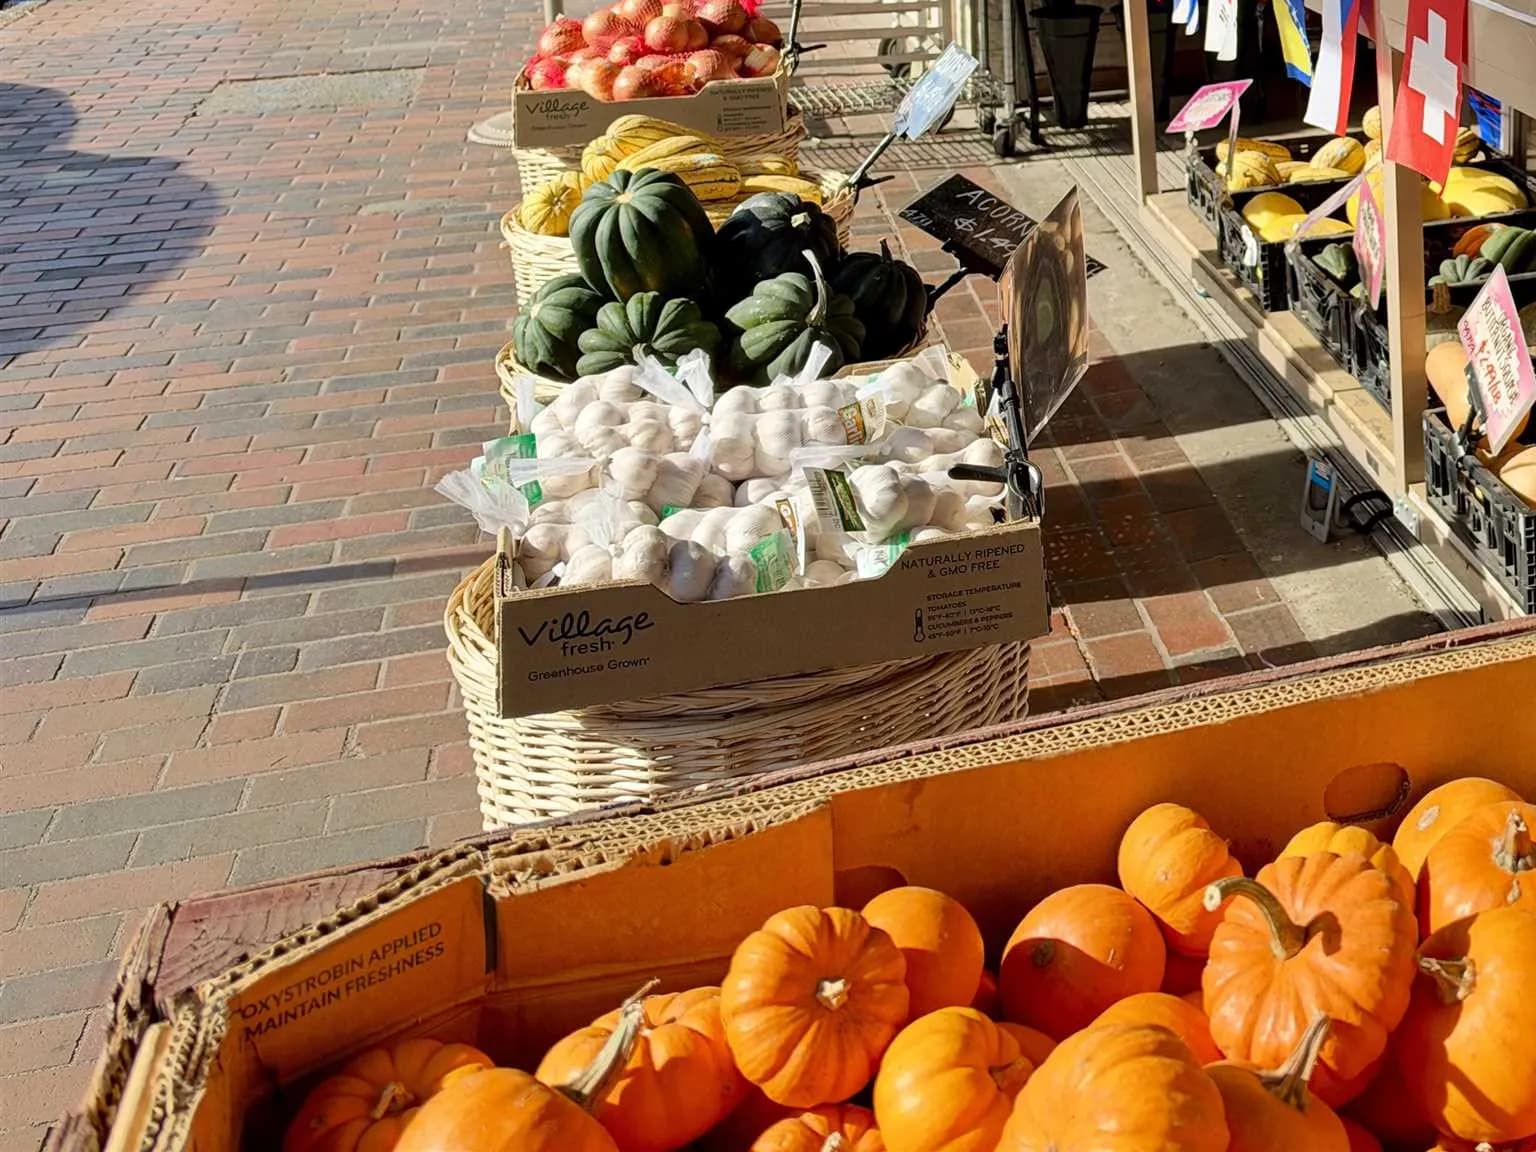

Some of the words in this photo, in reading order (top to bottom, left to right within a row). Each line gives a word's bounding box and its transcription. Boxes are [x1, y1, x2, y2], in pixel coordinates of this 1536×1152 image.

[956, 189, 1038, 238] ACORN
[901, 551, 972, 570] NATURALLY
[975, 543, 1025, 559] RIPENED
[927, 569, 937, 579] &
[940, 564, 968, 577] GMO
[971, 559, 1000, 573] FREE
[926, 590, 964, 601] STORAGE
[965, 581, 1021, 596] TEMPERATURE
[927, 601, 967, 612] TOMATOES
[518, 610, 655, 646] Village
[561, 637, 612, 656] fresh
[528, 664, 605, 682] Greenhouse
[608, 657, 650, 670] Grown
[368, 921, 443, 966] APPLIED
[244, 991, 342, 1041] MAINTAIN
[345, 941, 445, 995] FRESHNESS
